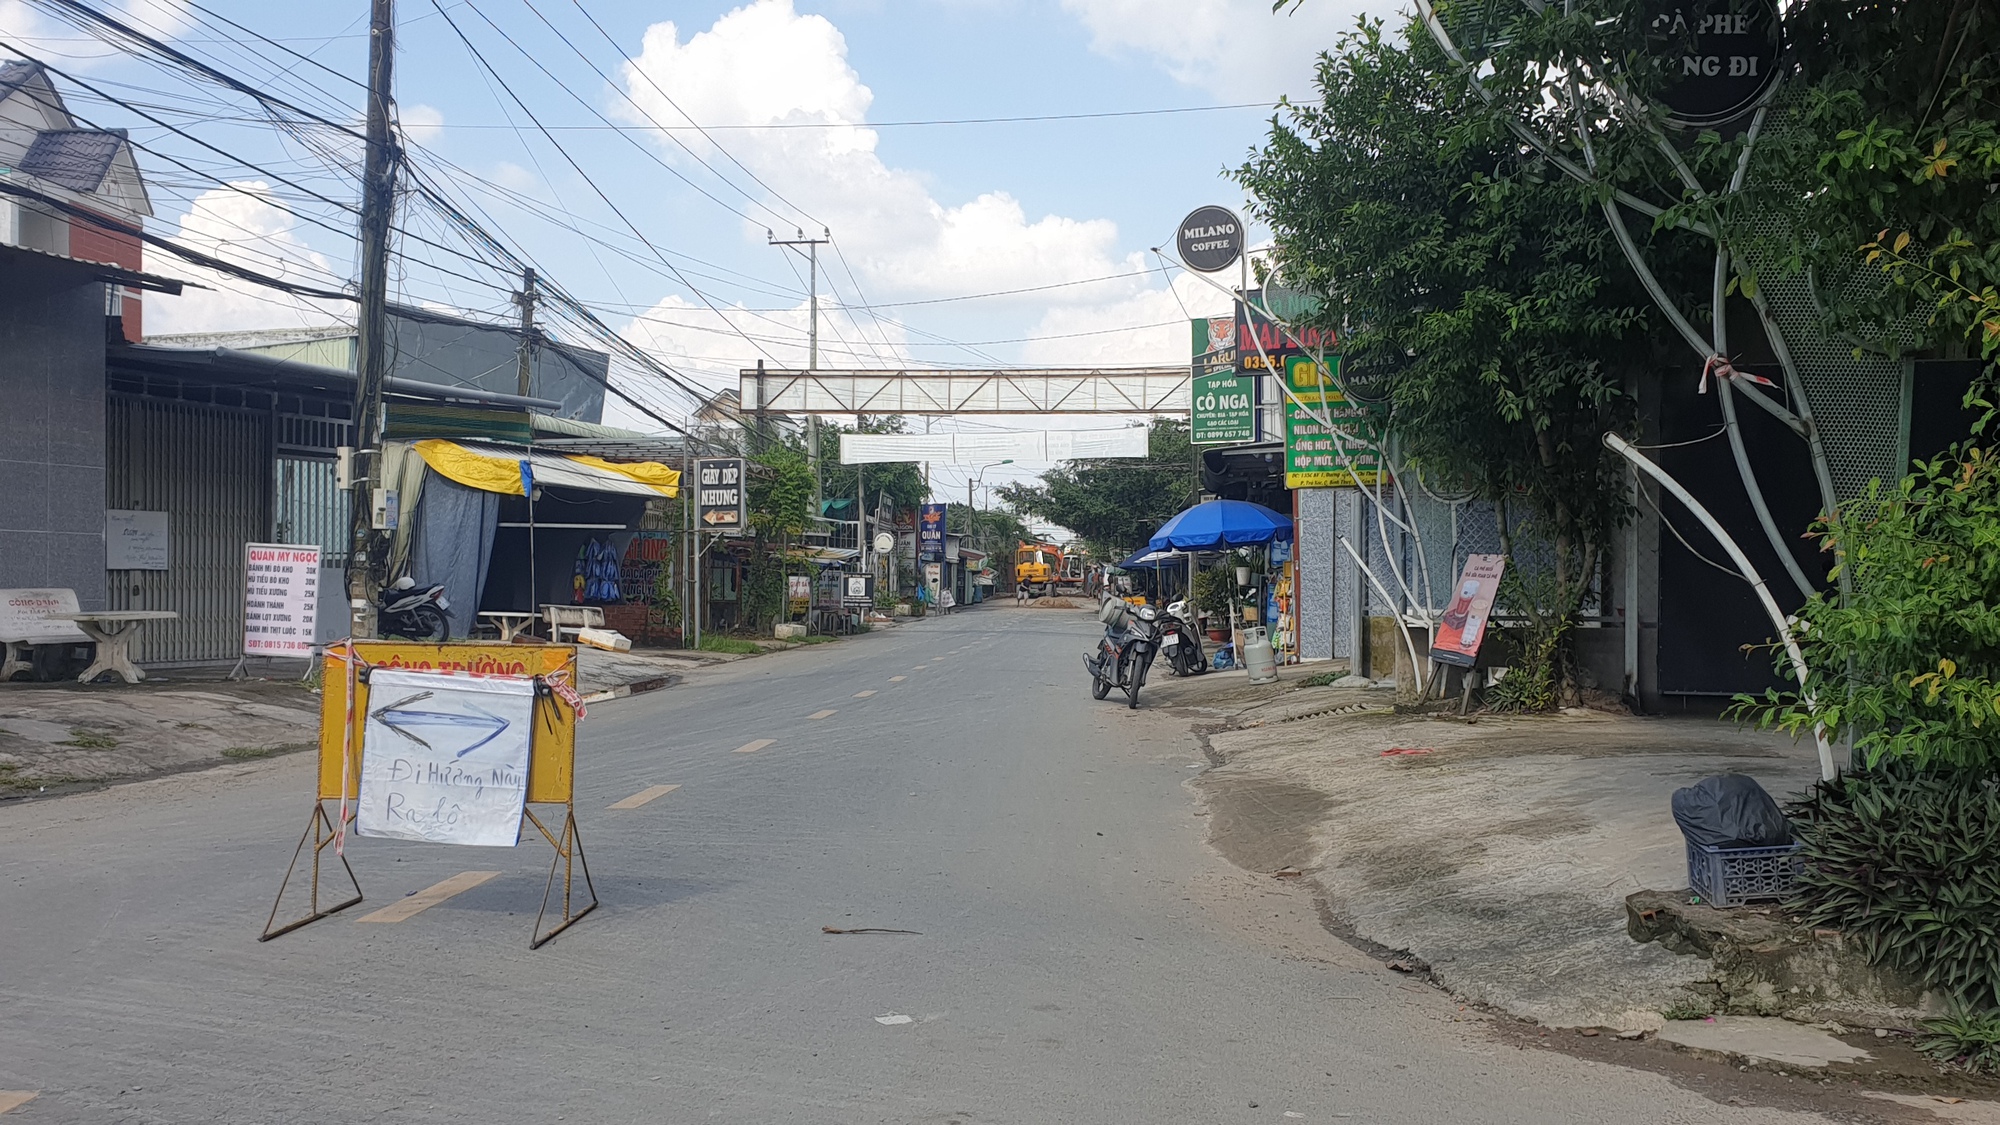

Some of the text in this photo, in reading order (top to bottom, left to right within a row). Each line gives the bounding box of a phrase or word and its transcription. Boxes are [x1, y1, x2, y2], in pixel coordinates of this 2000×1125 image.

[1728, 55, 1759, 77] ĐI
[1184, 224, 1235, 240] MILANO
[1191, 240, 1230, 252] COFFEE
[1240, 323, 1281, 351] MAI
[1203, 350, 1237, 369] LARU
[1207, 378, 1238, 391] TẠP HÓA
[1196, 391, 1249, 411] CÔ NGA
[1207, 430, 1224, 439] 0899
[1224, 430, 1236, 438] 657
[1238, 429, 1250, 437] 748
[1294, 425, 1319, 435] NILON
[1295, 439, 1313, 452] ỐNG
[1295, 455, 1312, 468] HỘP
[701, 463, 739, 485] GIÀY DÉP
[701, 489, 739, 506] NHUNG
[292, 552, 318, 566] NGỌC
[248, 563, 264, 573] BÁNH
[282, 565, 294, 574] KHO
[306, 566, 317, 575] 30K
[278, 576, 290, 585] KHO
[305, 578, 316, 586] 30K
[304, 590, 315, 598] 25K
[303, 603, 314, 611] 25K
[246, 611, 261, 621] BÁNH
[302, 615, 313, 624] 20K
[245, 624, 260, 633] BÁNH
[302, 628, 312, 636] 15K
[264, 640, 281, 649] 0815
[282, 641, 295, 650] 736
[387, 758, 522, 799] Đi Hướng Này
[387, 792, 424, 823] Ra
